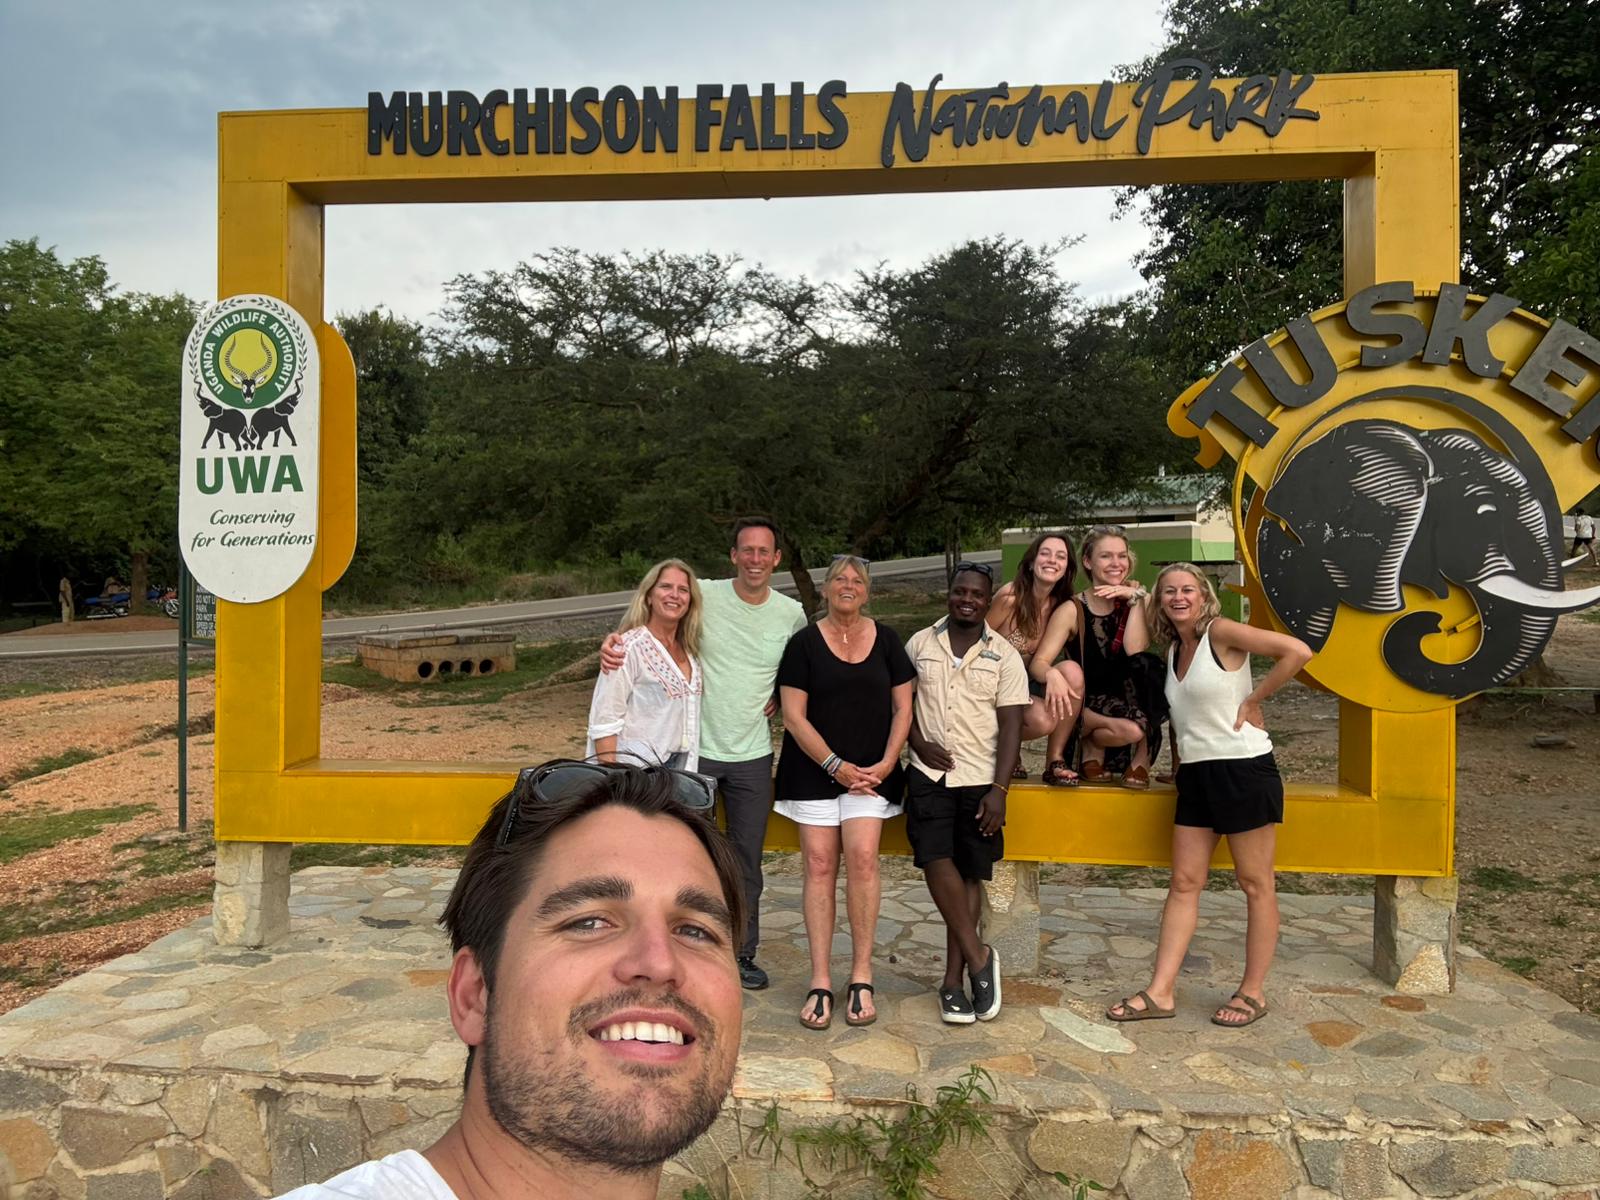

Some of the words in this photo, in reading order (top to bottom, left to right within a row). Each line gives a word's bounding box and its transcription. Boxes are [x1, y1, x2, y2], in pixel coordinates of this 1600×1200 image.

[367, 85, 679, 156] MURCHISON
[695, 79, 849, 152] FALLS
[211, 311, 268, 338] WILDLIFE
[203, 342, 224, 394] UGANDA
[268, 322, 294, 392] AUTHORITY
[196, 455, 304, 495] UWA
[209, 509, 296, 528] Conserving
[191, 532, 215, 552] for
[220, 531, 315, 547] Generations
